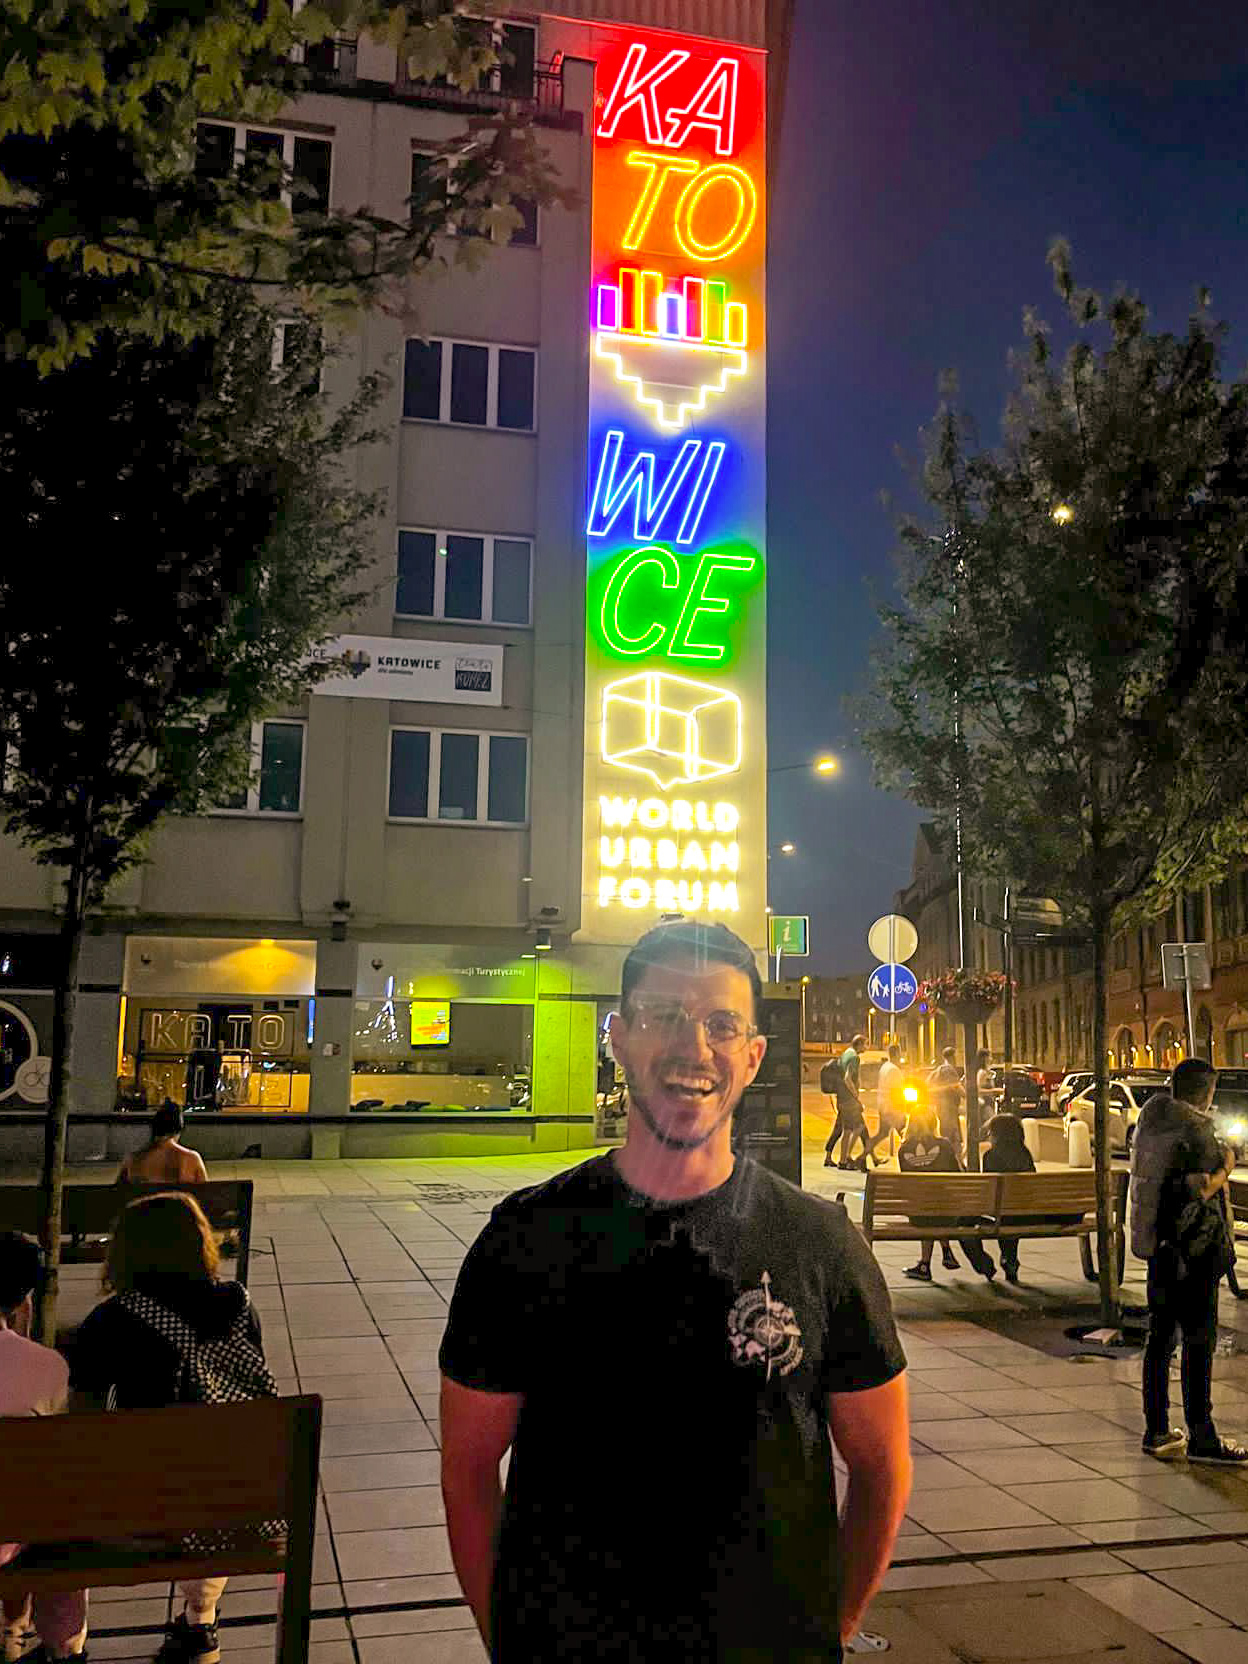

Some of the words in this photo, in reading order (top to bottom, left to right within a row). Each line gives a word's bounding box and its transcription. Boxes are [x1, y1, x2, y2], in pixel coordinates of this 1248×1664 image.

[597, 43, 739, 156] KA
[621, 150, 758, 263] TO
[586, 430, 726, 545] WI
[601, 546, 756, 660] CE
[377, 655, 442, 671] KATOWICE
[599, 795, 740, 833] WORLD
[599, 835, 741, 873] URBAN
[598, 876, 740, 912] FORUM
[150, 1012, 286, 1050] KATO
